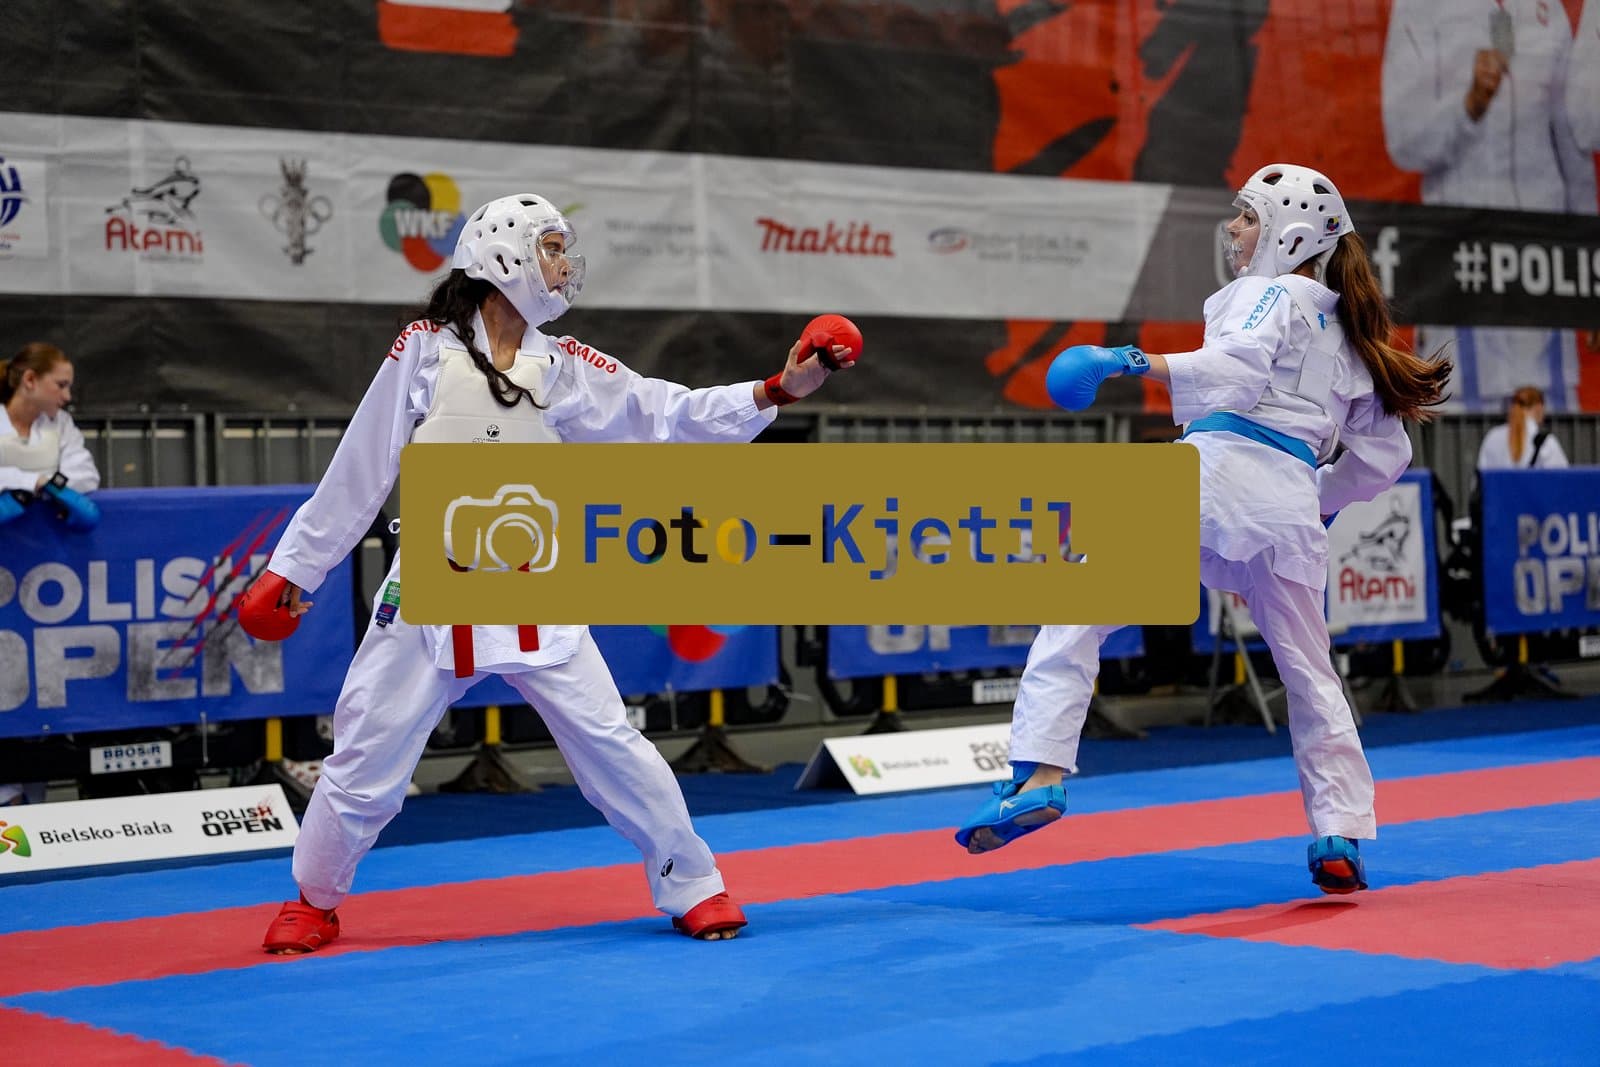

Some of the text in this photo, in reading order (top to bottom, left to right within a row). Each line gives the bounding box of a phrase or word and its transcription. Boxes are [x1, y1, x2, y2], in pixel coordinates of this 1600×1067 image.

[105, 216, 204, 254] Atemi
[394, 208, 452, 239] WKF
[384, 319, 448, 362] TOKAID
[1517, 511, 1600, 557] POLI
[1338, 566, 1416, 604] Atemi
[202, 805, 273, 822] POLISH
[202, 817, 284, 837] OPEN
